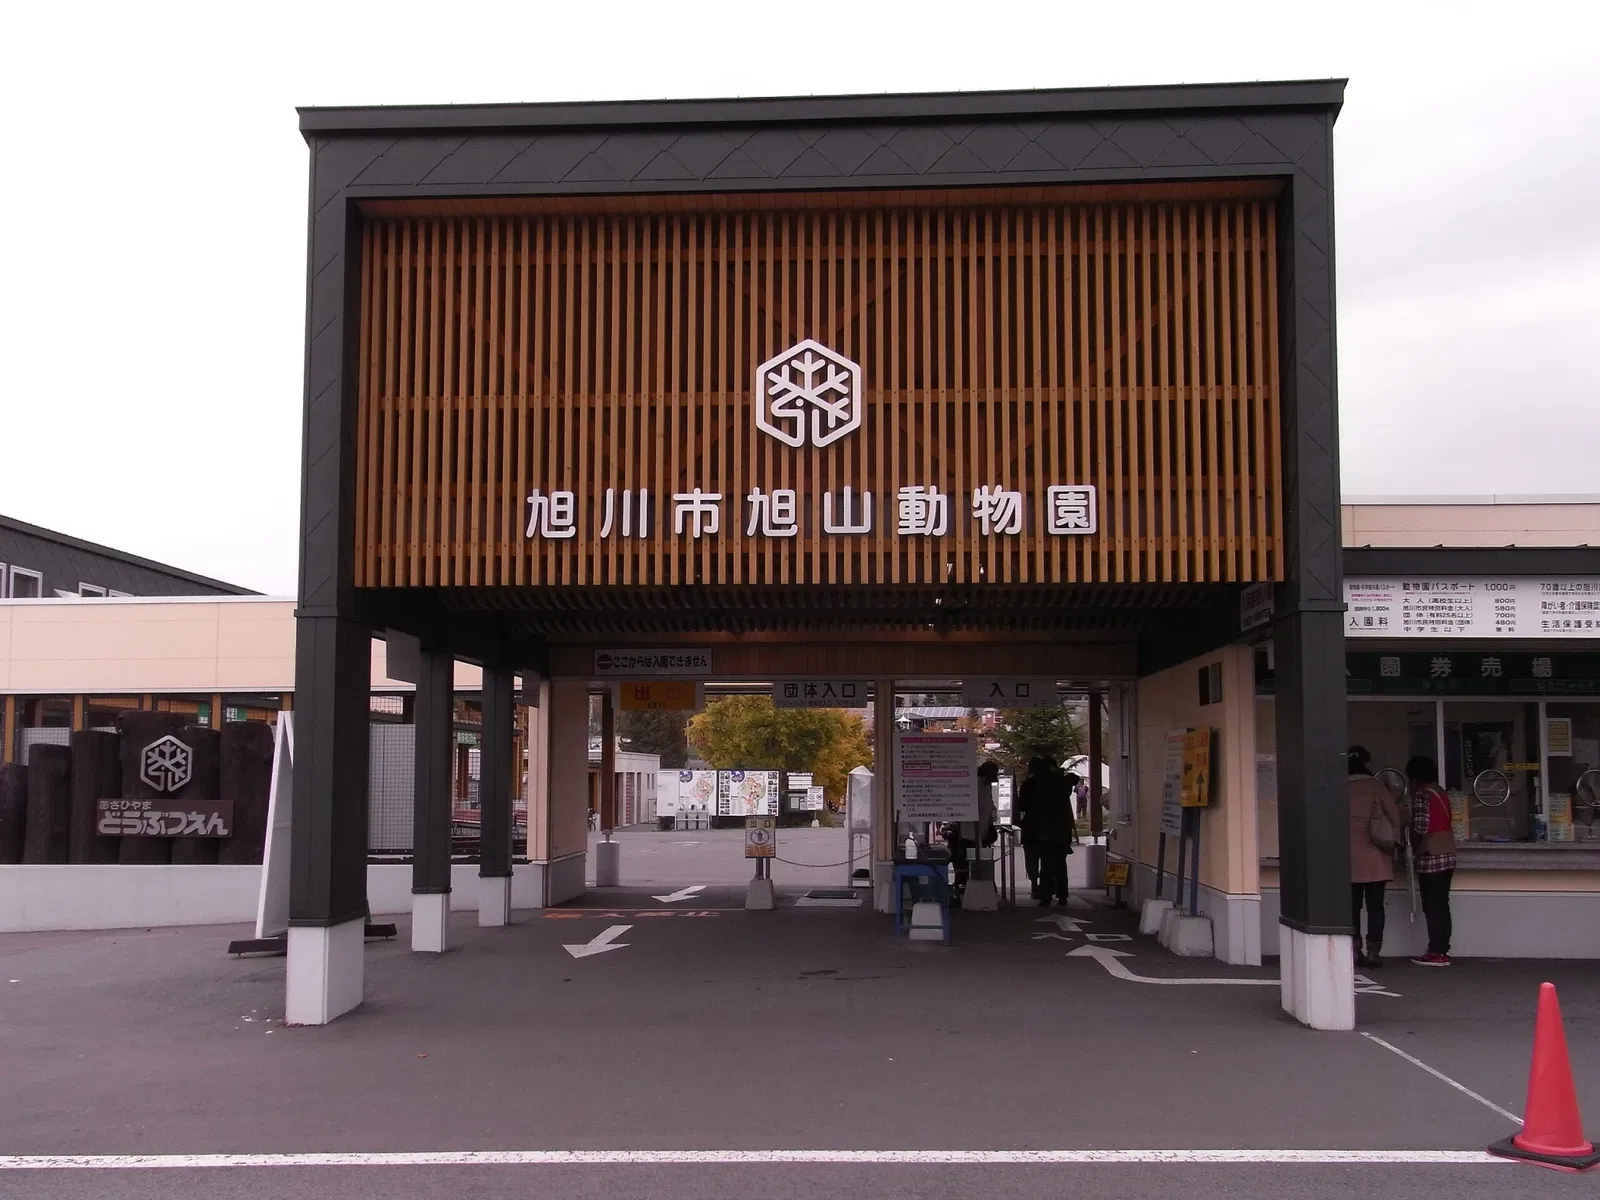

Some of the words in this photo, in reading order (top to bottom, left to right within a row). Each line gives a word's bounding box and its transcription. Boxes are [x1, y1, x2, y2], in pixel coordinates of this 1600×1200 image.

[526, 484, 1097, 538] 旭川市旭山動物園
[1402, 582, 1475, 591] 動物園パスポート
[1349, 616, 1389, 627] 入園料
[612, 655, 708, 668] ここからは入園できません
[1346, 656, 1553, 679] 園券売場
[784, 682, 856, 698] 団体入口
[989, 682, 1030, 698] 入口
[99, 800, 152, 810] あさひやま
[98, 811, 229, 836] どうぶつえん
[1031, 932, 1134, 942] 入口
